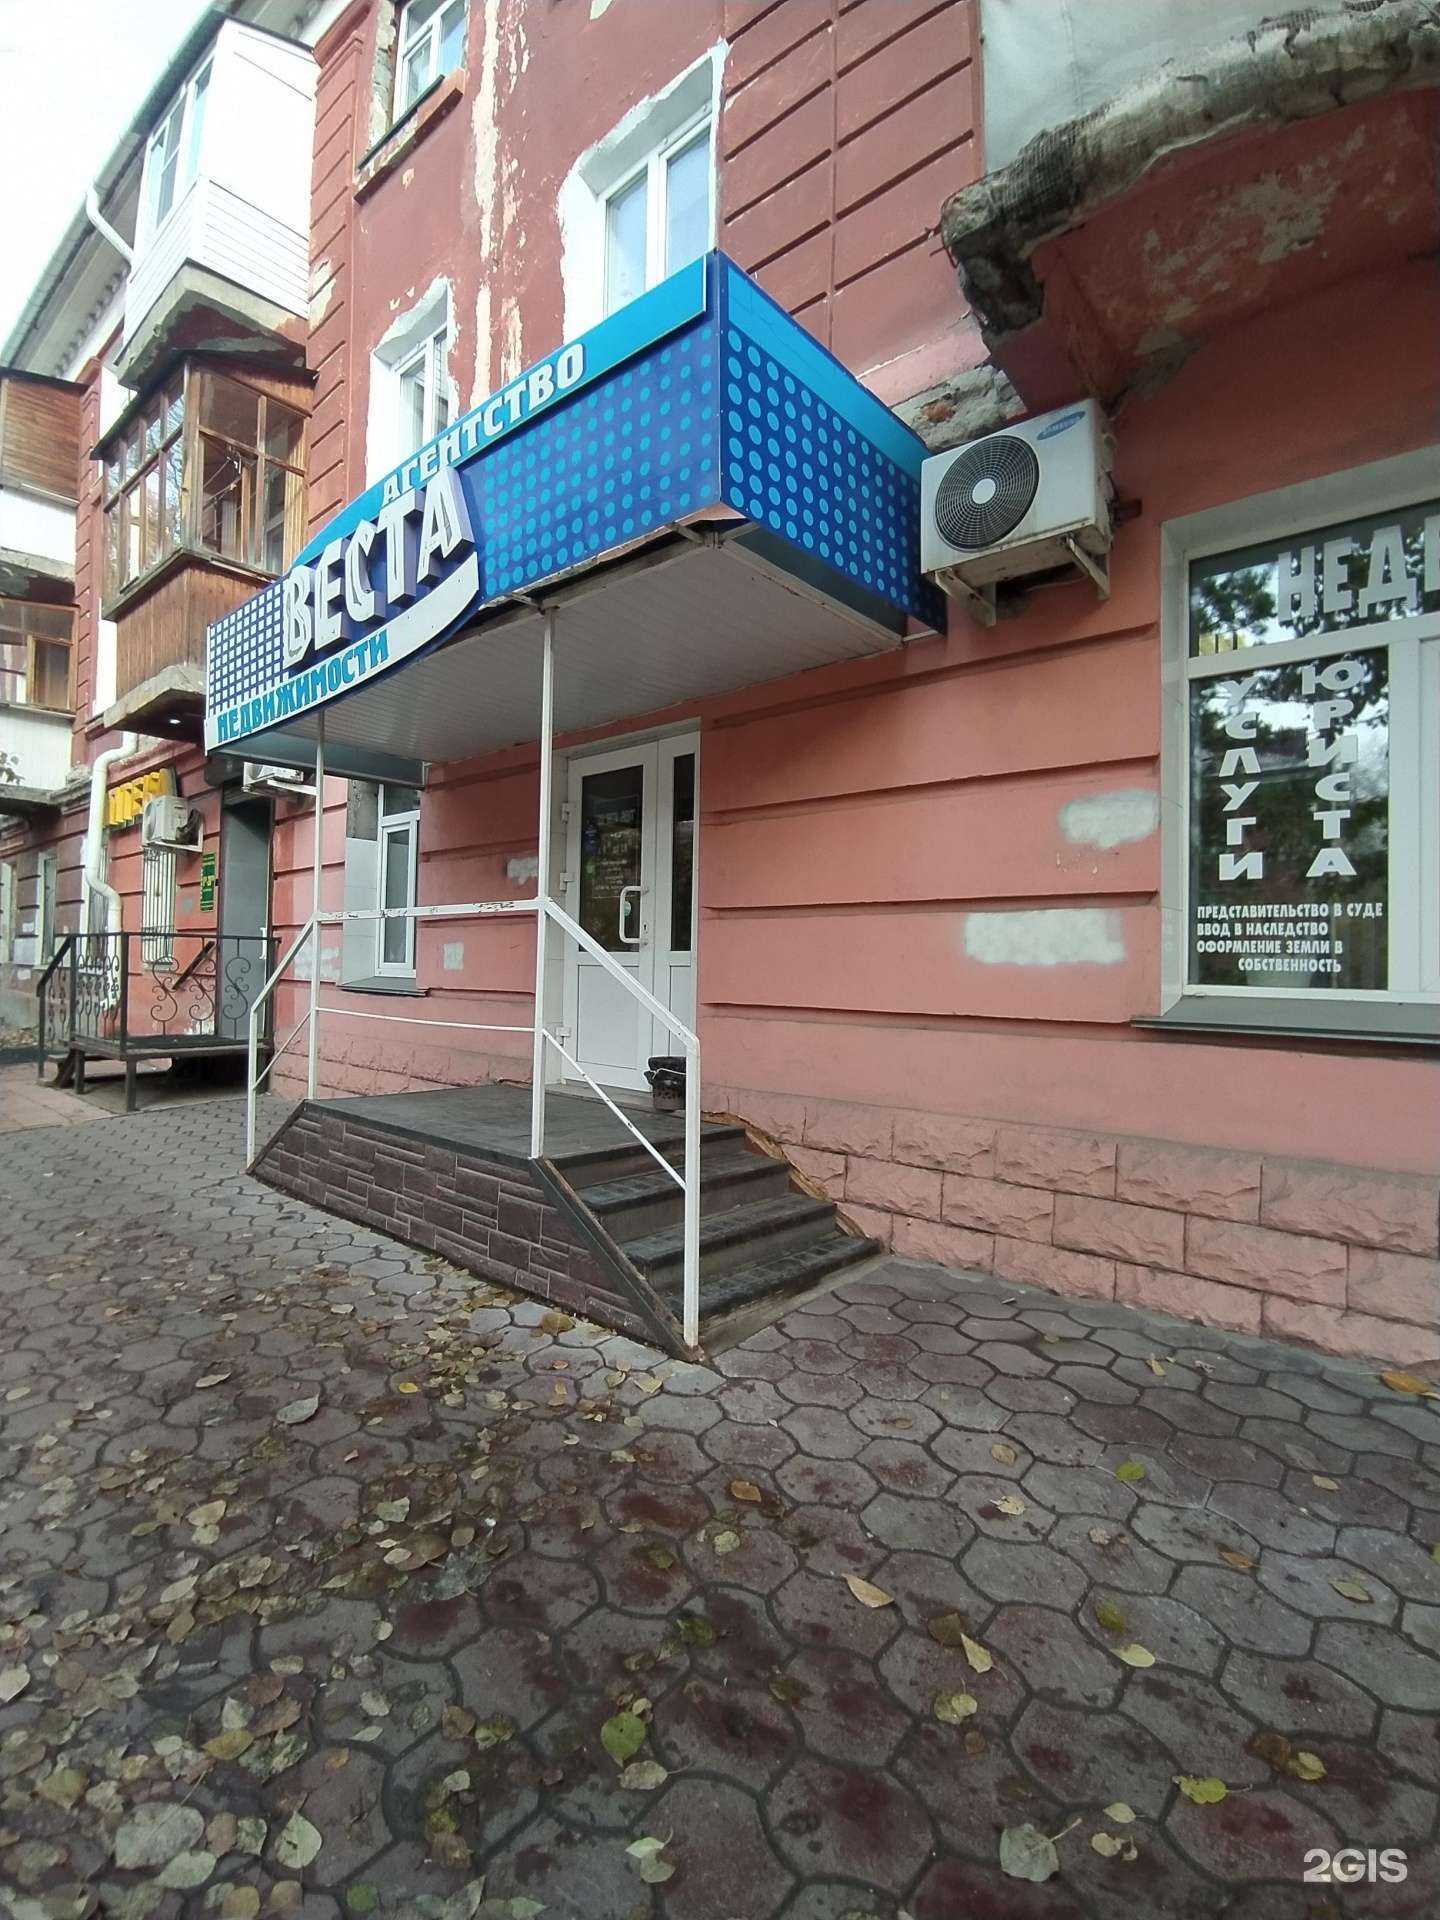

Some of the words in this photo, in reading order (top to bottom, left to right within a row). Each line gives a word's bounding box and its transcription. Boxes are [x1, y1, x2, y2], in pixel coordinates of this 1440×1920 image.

[383, 343, 584, 506] АГЕНТСТВО
[282, 465, 476, 669] ВЕСТА
[217, 628, 391, 744] НЕДВИЖИМОСТИ
[1218, 674, 1265, 881] УСЛУГИ
[1301, 659, 1366, 878] ЮРИСТА
[1196, 940, 1282, 955] ОФОРМЛЕНИЕ
[1285, 940, 1330, 955] ЗЕМЛИ
[1334, 940, 1344, 955] В
[1197, 903, 1329, 920] ПРЕДСТАВИТЕЛЬСТВО
[1333, 902, 1343, 918] В
[1346, 902, 1384, 919] СУДЕ
[1197, 922, 1231, 938] ВВОД
[1234, 922, 1243, 936] В
[1246, 921, 1329, 938] НАСЛЕДСТВО
[1237, 957, 1342, 974] СОБСТВЕННОСТЬ
